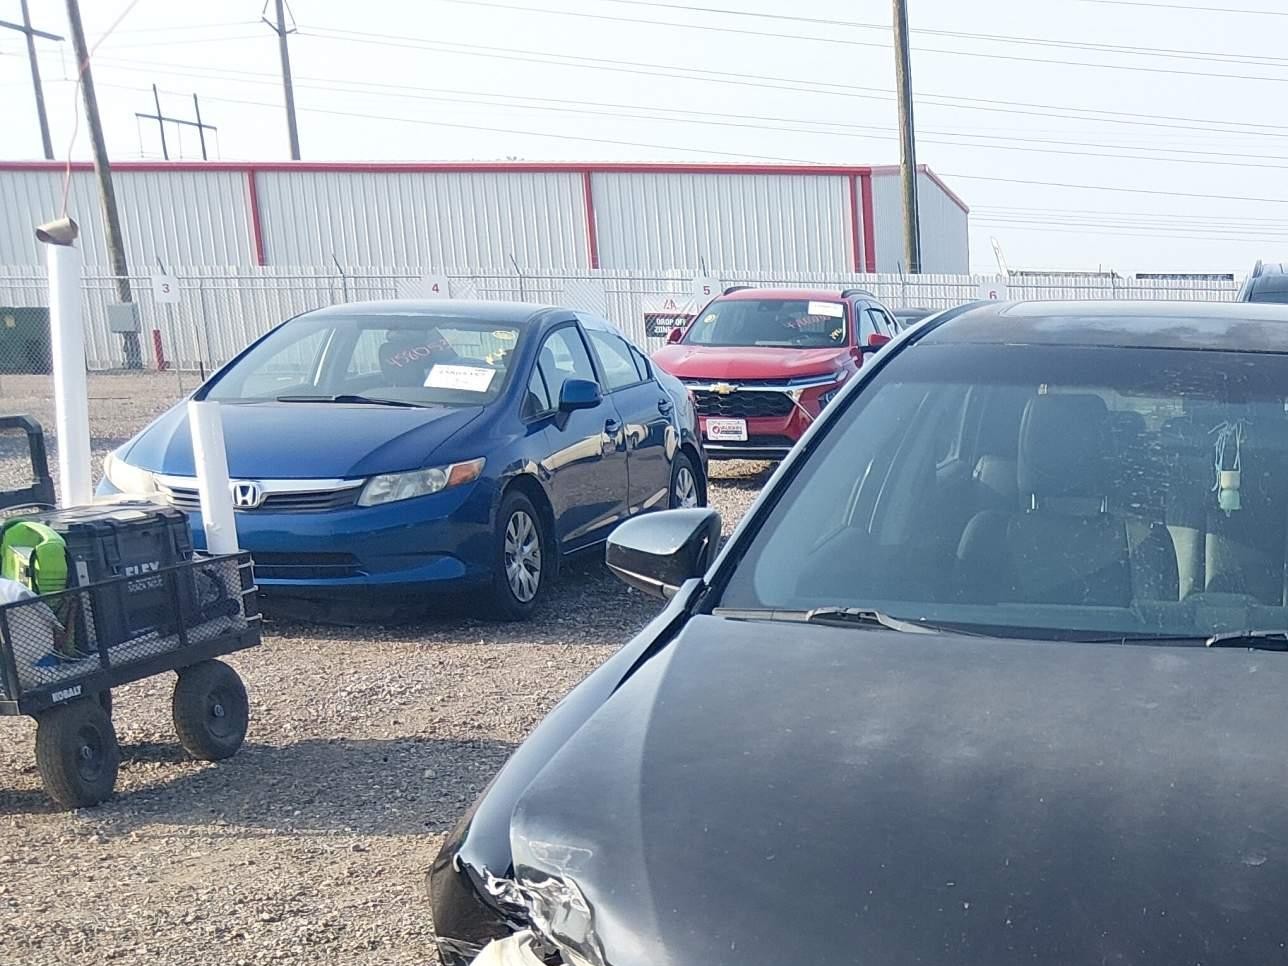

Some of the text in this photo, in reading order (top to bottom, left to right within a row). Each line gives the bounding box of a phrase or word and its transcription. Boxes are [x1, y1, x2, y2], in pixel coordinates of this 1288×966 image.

[161, 283, 170, 294] 3
[431, 283, 440, 293] 4
[703, 285, 711, 295] 5
[989, 290, 998, 300] 6
[656, 318, 674, 326] DROP
[51, 684, 82, 703] KOBALT
